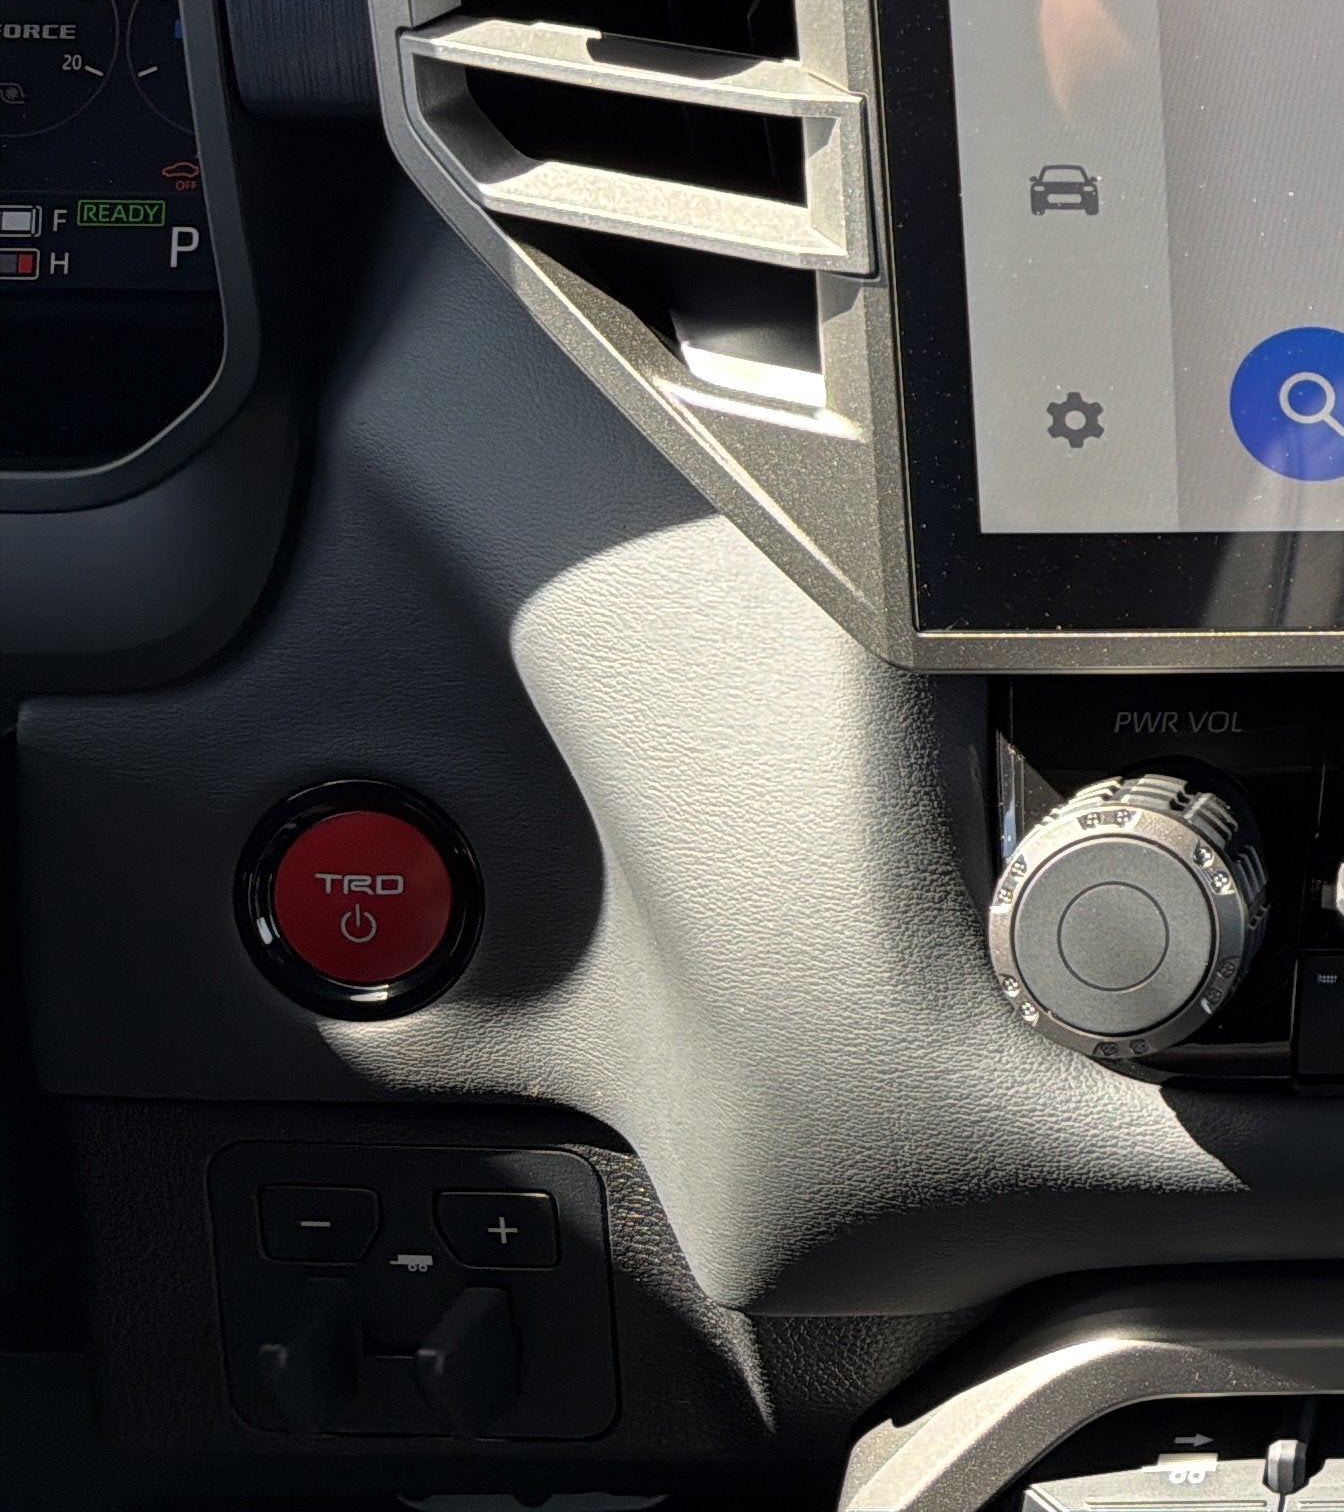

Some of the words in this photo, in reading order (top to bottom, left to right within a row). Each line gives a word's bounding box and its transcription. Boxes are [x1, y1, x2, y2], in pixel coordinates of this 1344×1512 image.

[0, 24, 77, 40] ORCE
[62, 54, 83, 71] 20
[52, 209, 68, 233] F
[82, 204, 161, 223] READY
[170, 227, 200, 268] P
[49, 253, 70, 276] H
[1113, 711, 1179, 734] PWR
[1188, 711, 1243, 734] VOL
[314, 872, 405, 896] TRD
